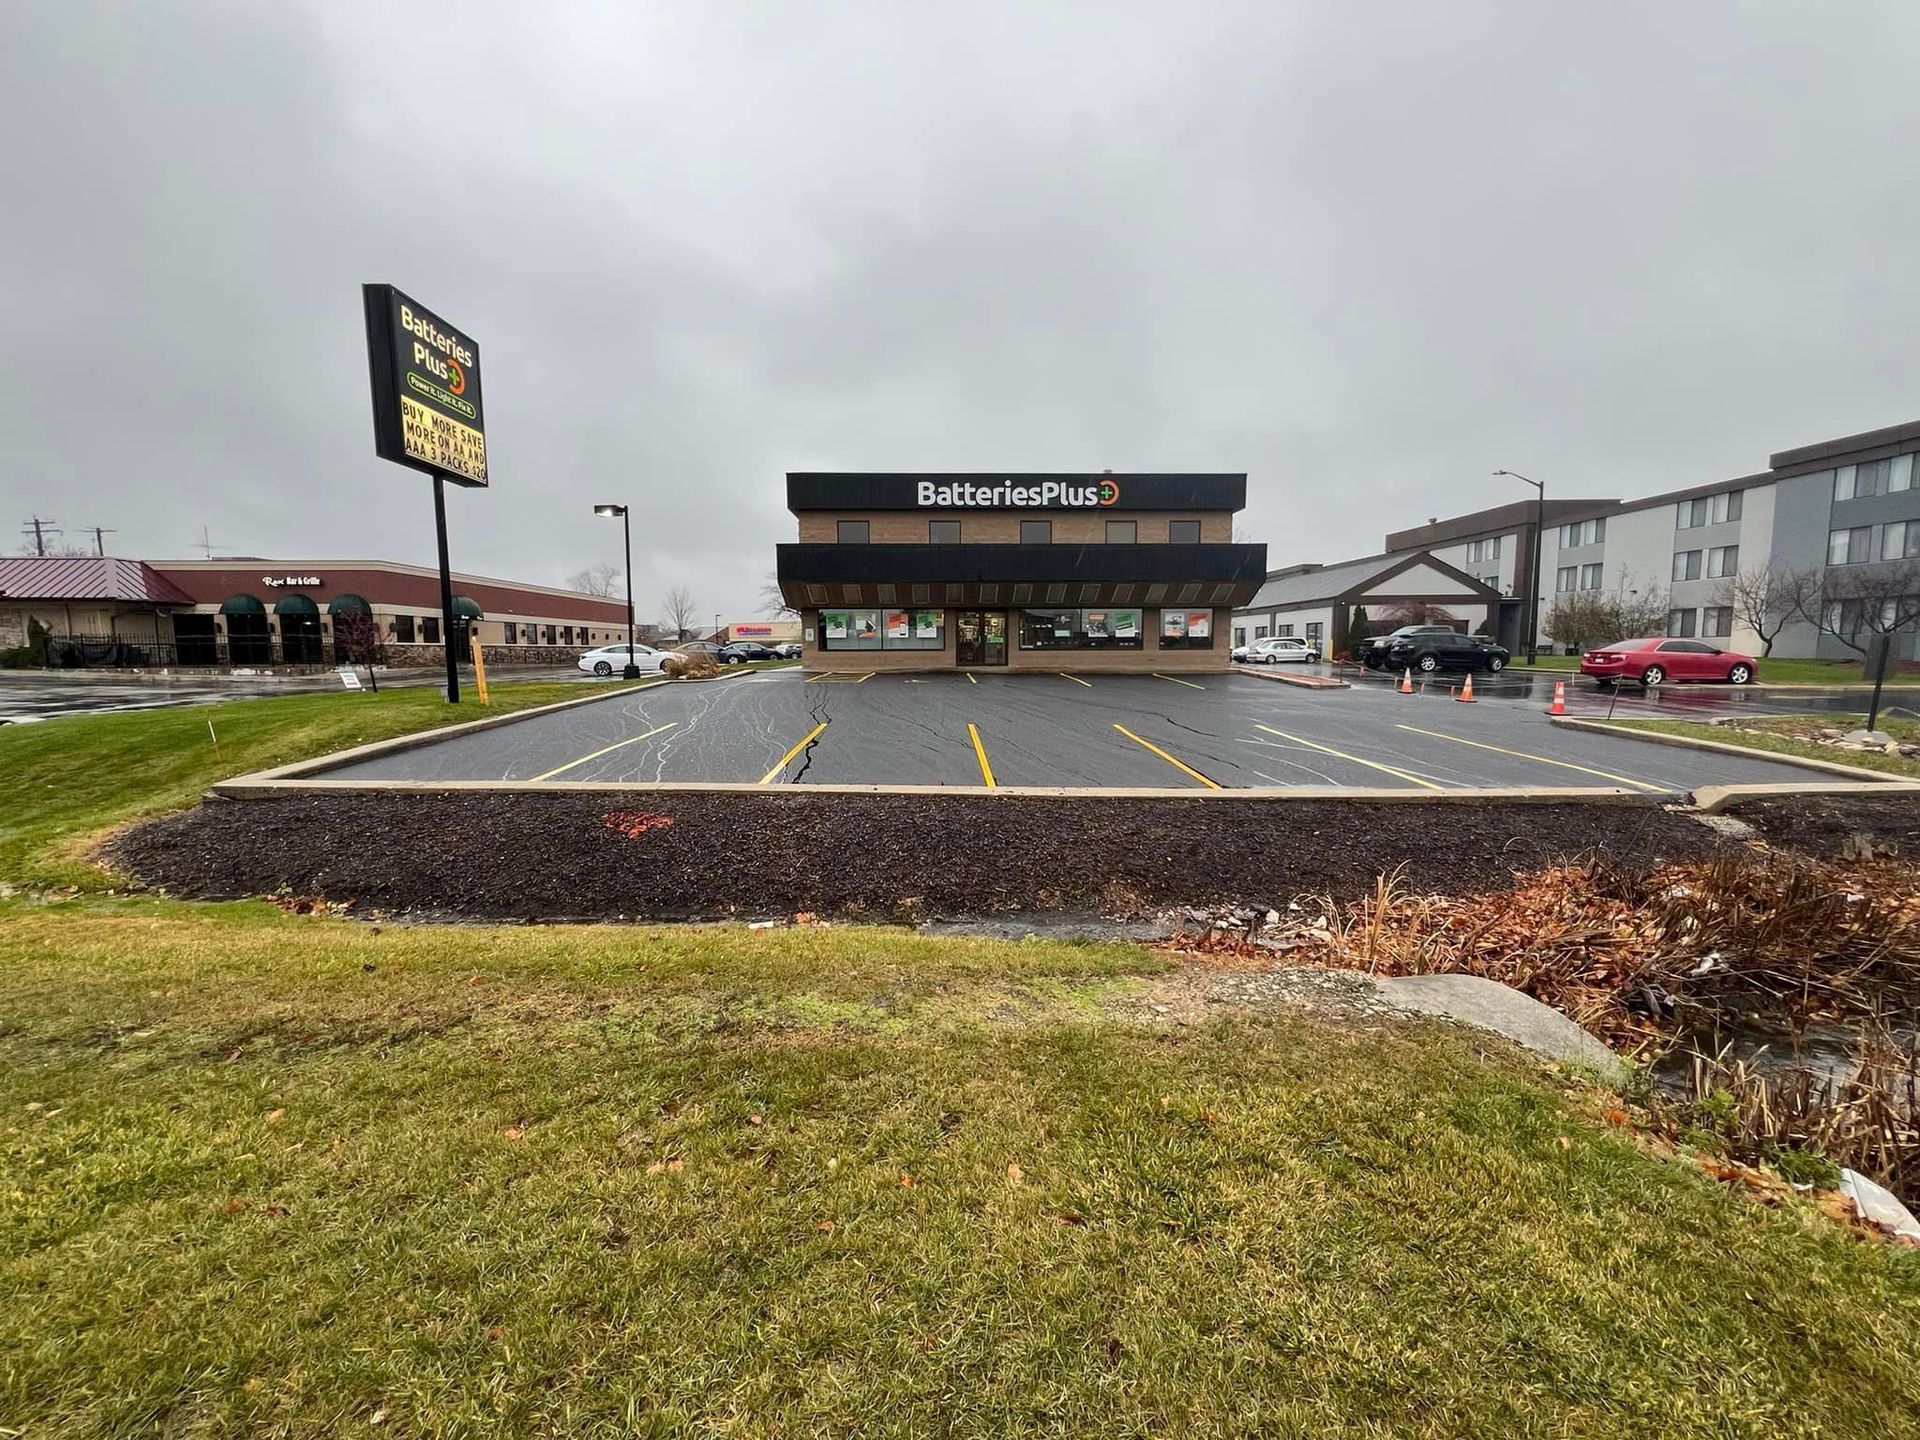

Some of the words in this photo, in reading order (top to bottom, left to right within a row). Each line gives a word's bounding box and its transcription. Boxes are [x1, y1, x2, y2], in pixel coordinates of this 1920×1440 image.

[401, 305, 473, 368] Batteries
[413, 342, 449, 380] Plus
[402, 402, 424, 423] BUY
[431, 415, 458, 439] MORE
[460, 429, 482, 450] SAVE
[406, 420, 436, 445] MORE
[438, 434, 450, 450] ON
[453, 442, 465, 457] AA
[468, 448, 485, 464] AND
[405, 438, 426, 457] AAA
[430, 447, 437, 460] 3
[441, 452, 469, 473] PACKS
[917, 480, 1099, 506] BatteriesPlus
